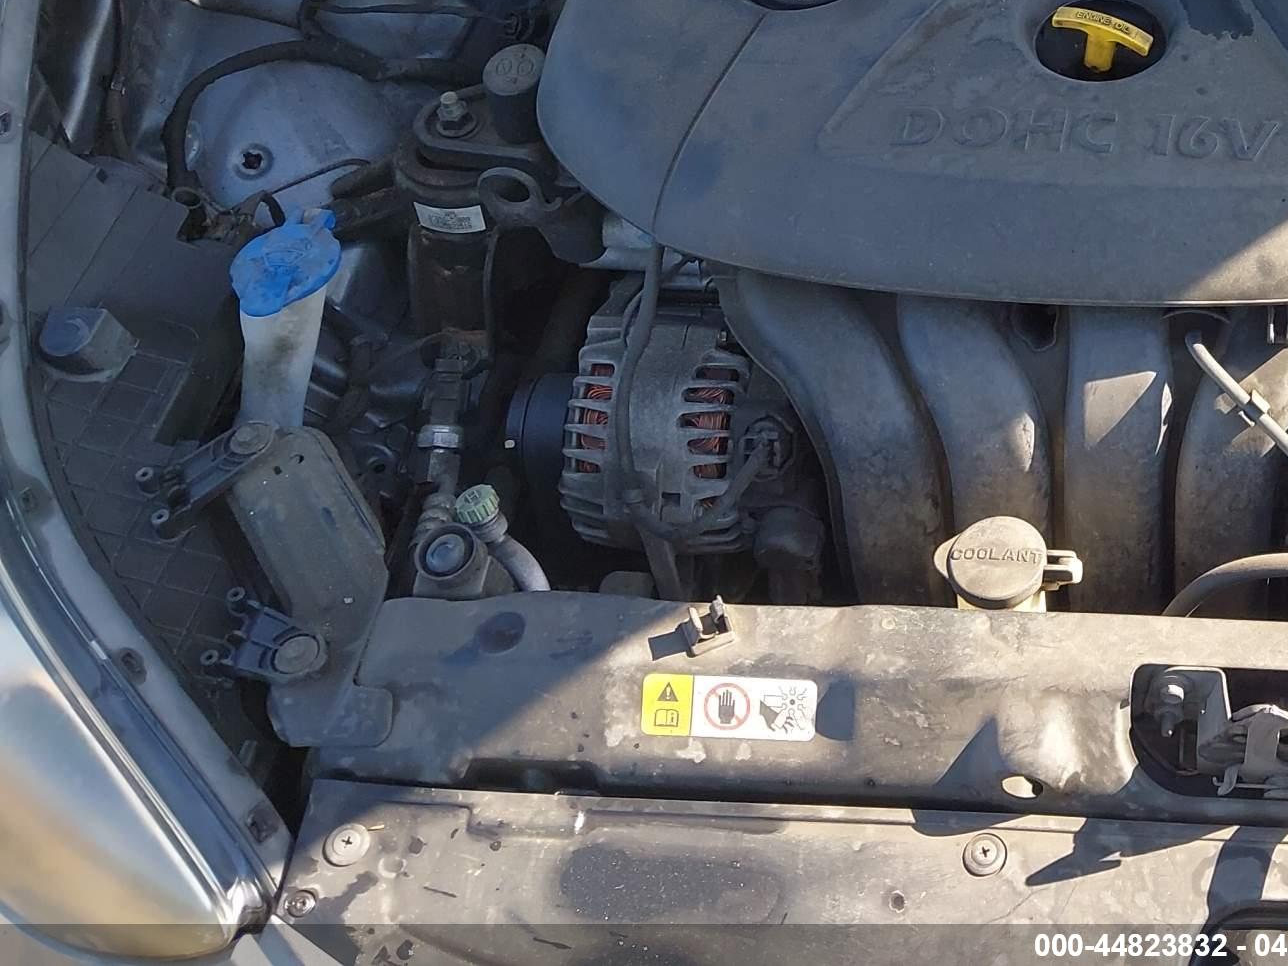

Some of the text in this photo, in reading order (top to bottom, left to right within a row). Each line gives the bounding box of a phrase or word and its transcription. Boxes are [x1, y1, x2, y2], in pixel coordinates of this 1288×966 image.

[1075, 10, 1131, 34] ENGINE OIL
[889, 105, 1281, 162] DOHC 16V
[950, 546, 1042, 565] COOLANT
